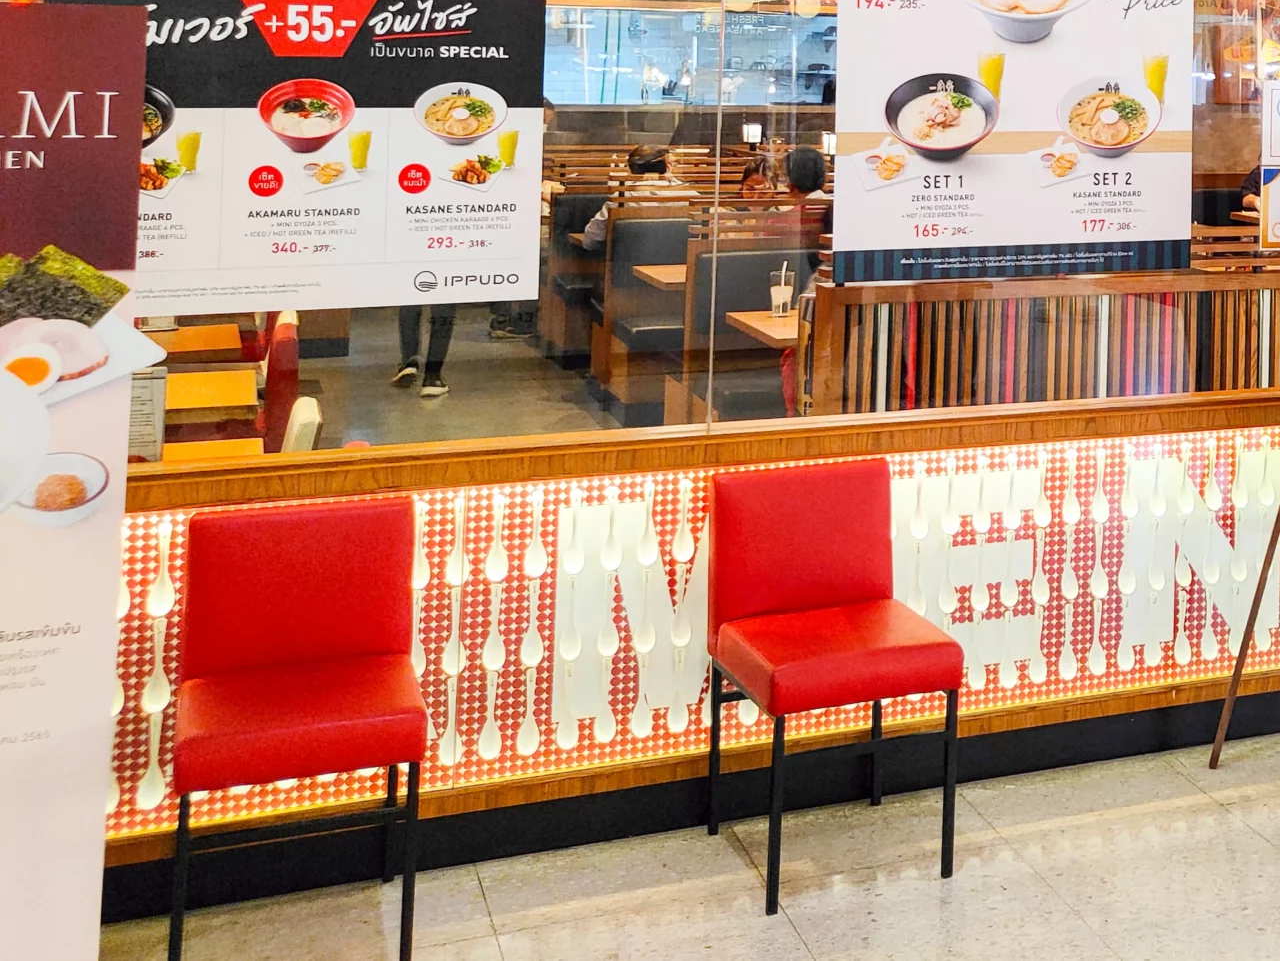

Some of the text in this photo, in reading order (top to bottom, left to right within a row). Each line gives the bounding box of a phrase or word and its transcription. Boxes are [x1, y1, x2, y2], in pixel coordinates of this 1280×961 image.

[264, 4, 357, 42] +55.-
[370, 43, 509, 59] เป็นขนาด SPECIAL
[0, 91, 120, 138] MI
[0, 150, 46, 169] EN
[923, 175, 963, 189] SET 1
[1093, 172, 1132, 186] SET 2
[247, 207, 360, 218] AKAMARU STANDARD
[406, 203, 517, 214] KASANE STANDARD
[138, 212, 172, 222] NDARD
[913, 224, 948, 238] 165.-
[1082, 219, 1114, 232] 177.-
[271, 242, 308, 253] 340.-
[427, 236, 464, 249] 293.-
[444, 273, 519, 286] IPPUDO
